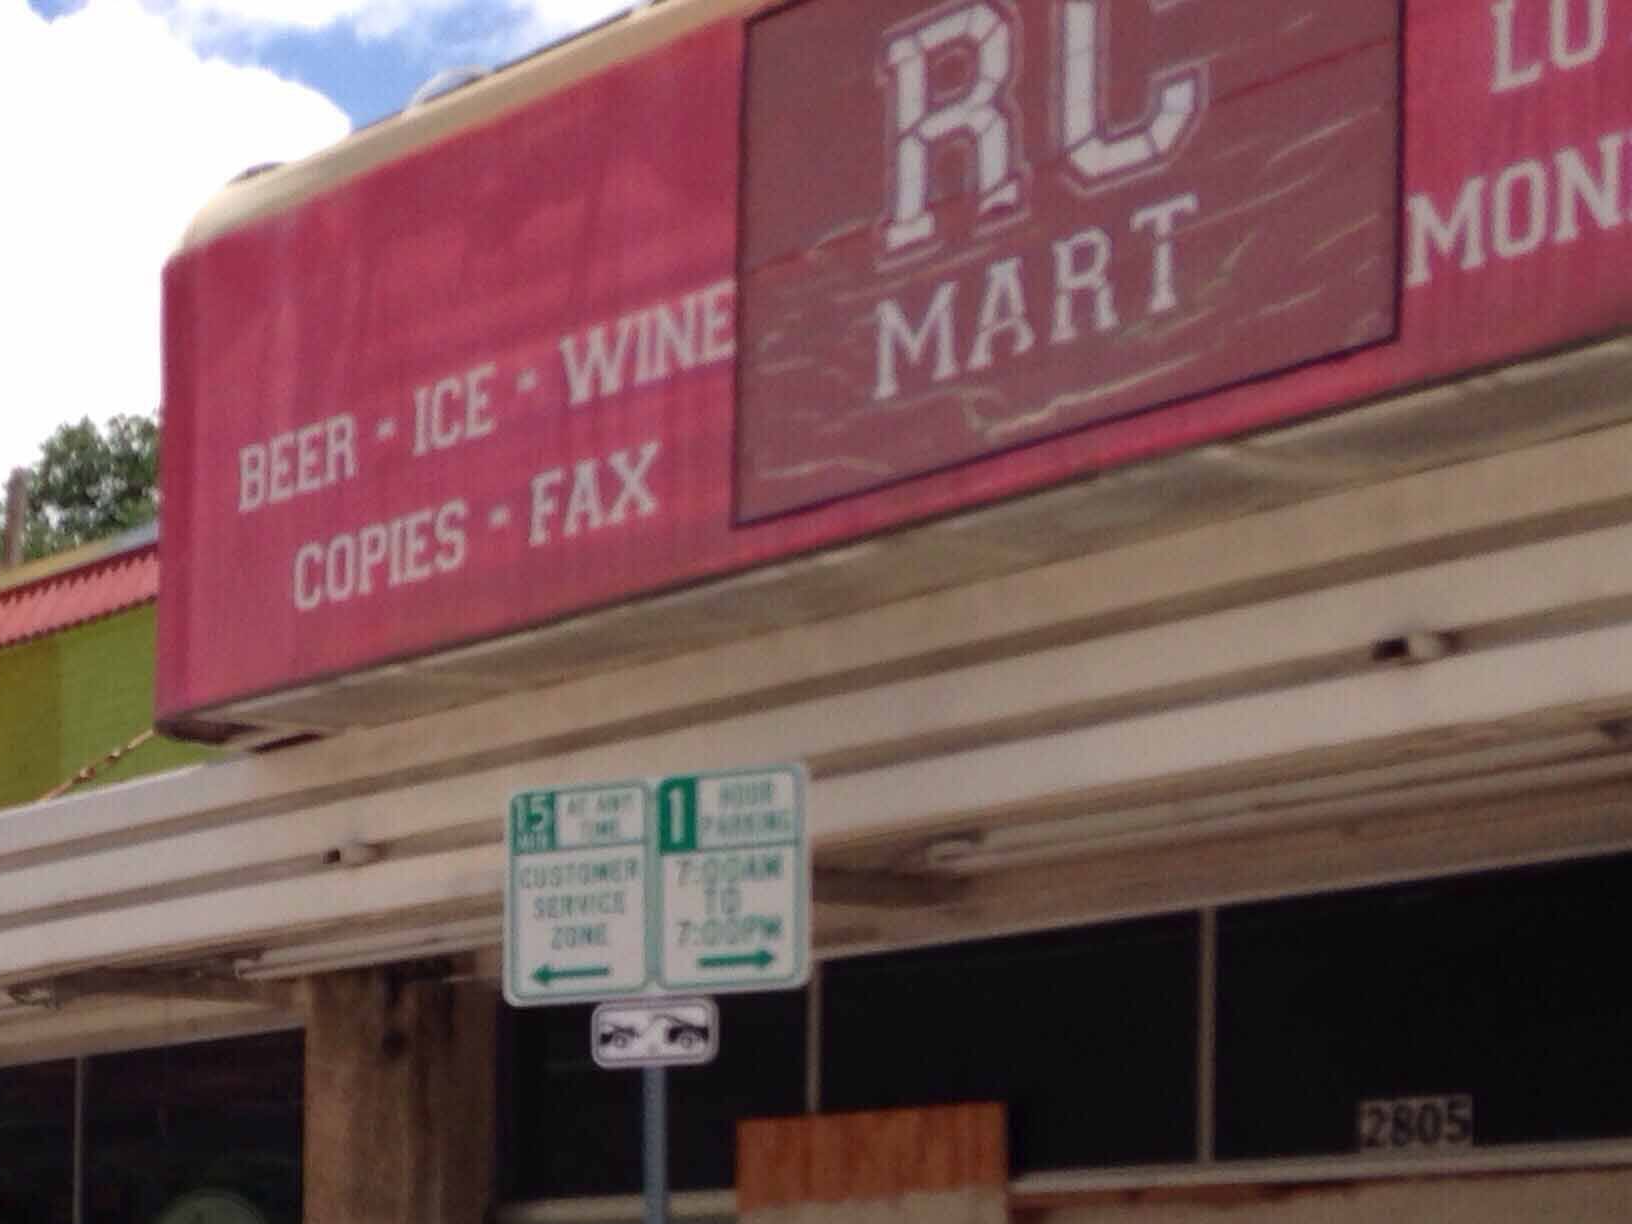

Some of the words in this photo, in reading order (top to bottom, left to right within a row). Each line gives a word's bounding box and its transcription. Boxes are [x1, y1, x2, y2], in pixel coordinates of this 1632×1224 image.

[1405, 130, 1632, 289] MON
[875, 194, 1199, 401] MART
[237, 413, 358, 512] BEER
[411, 363, 498, 456] ICE
[559, 278, 736, 406] WINE
[293, 499, 467, 610] COPIES
[528, 441, 662, 547] FAX
[515, 795, 550, 832] 15
[667, 786, 686, 845] 1
[519, 857, 640, 889] CUSTOMER
[676, 854, 783, 887] 7:00AM
[533, 891, 626, 919] SERVICE
[703, 887, 742, 915] TO
[551, 923, 610, 950] ZONE
[676, 916, 783, 948] 7:00PM
[1359, 1099, 1472, 1147] 2805
